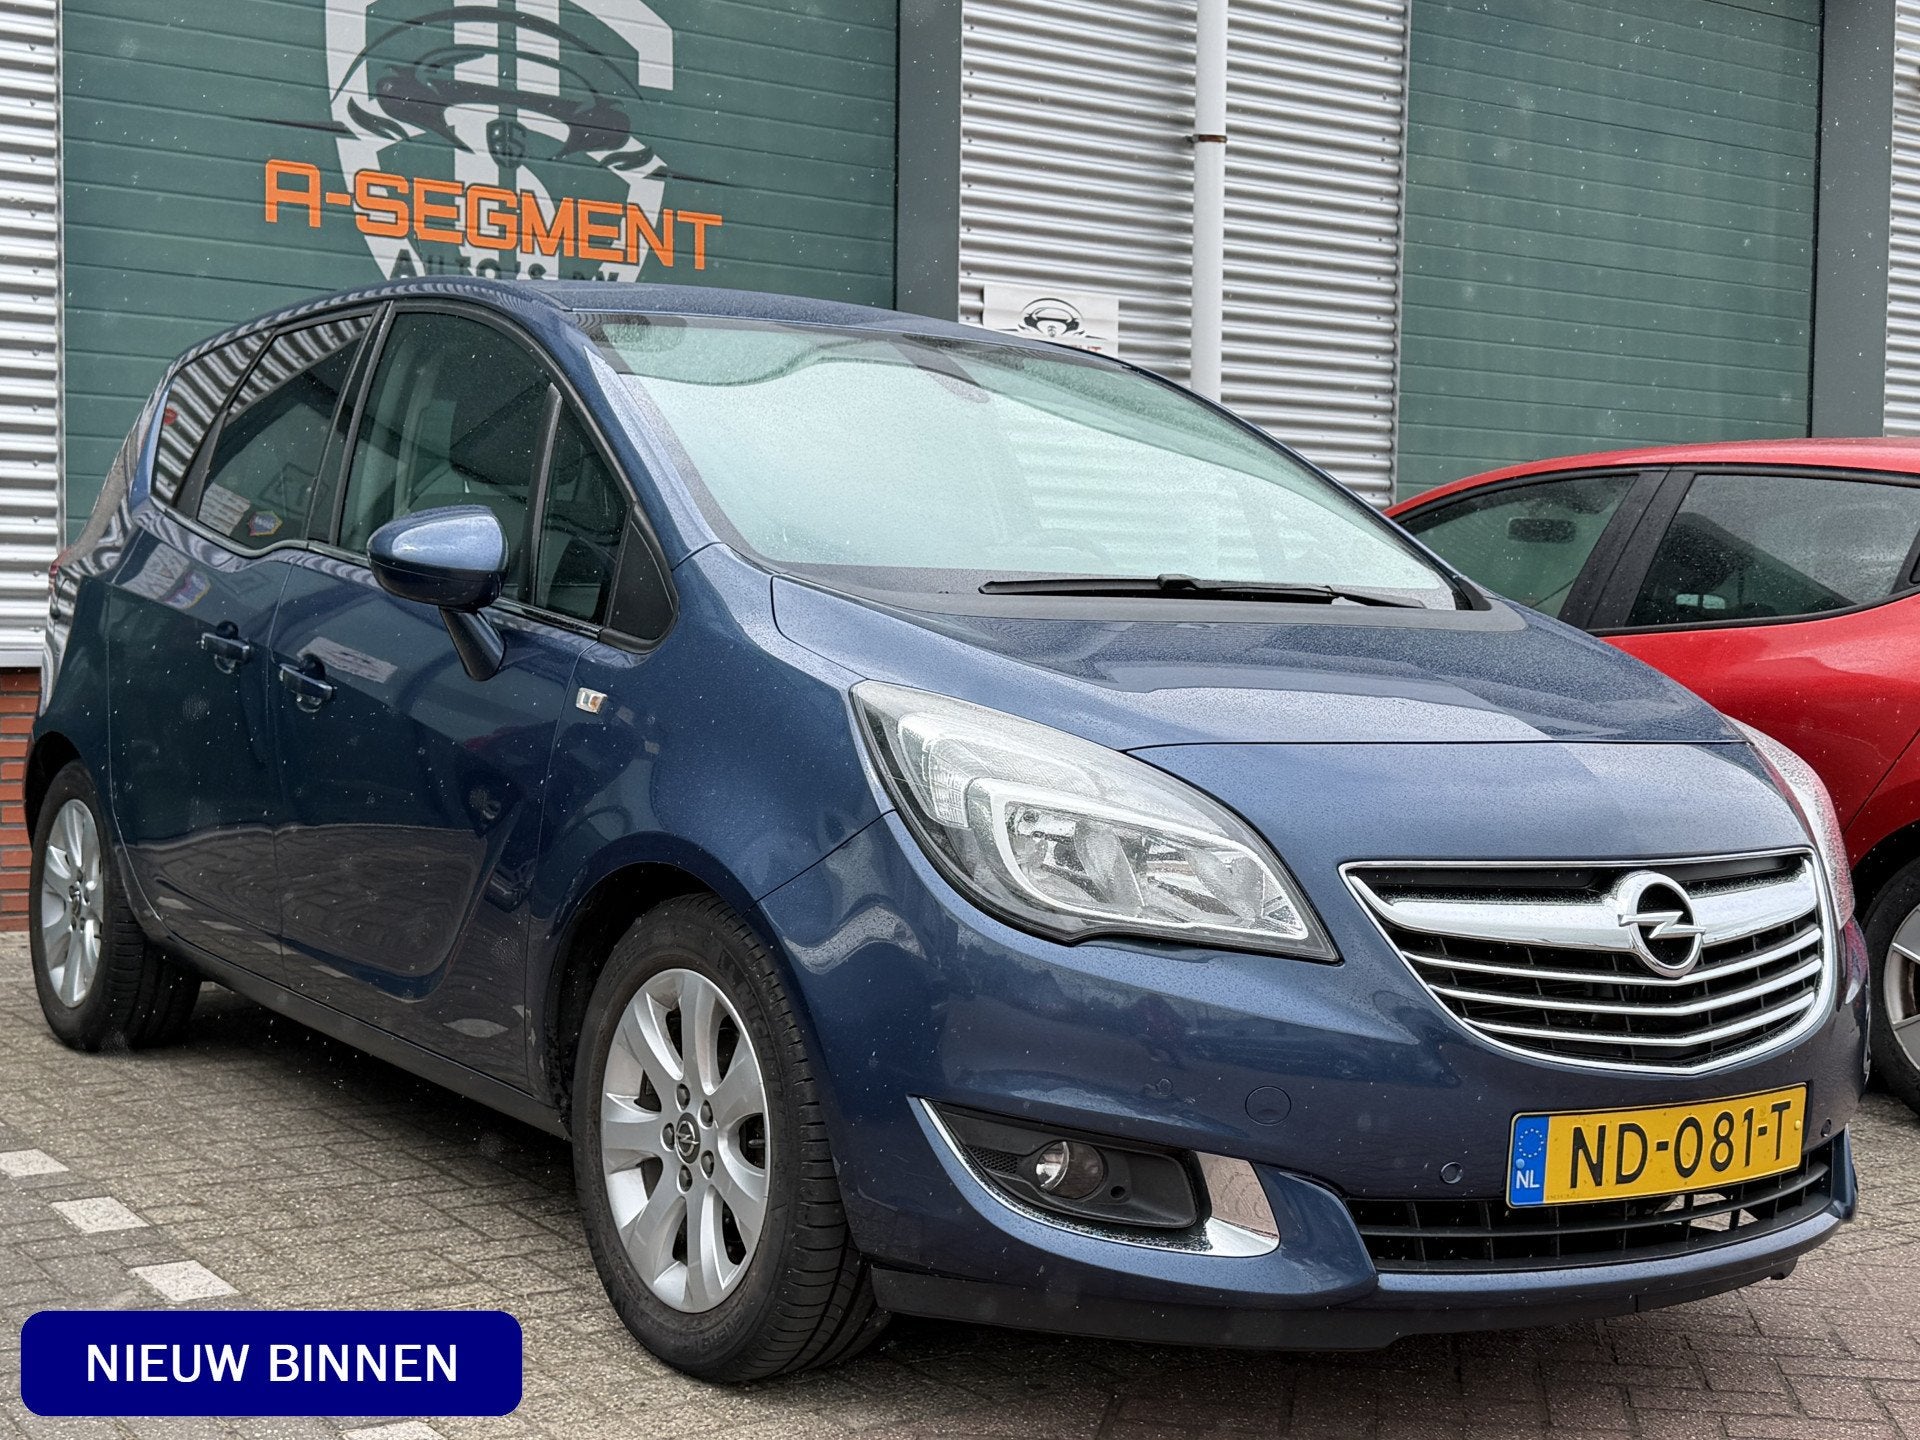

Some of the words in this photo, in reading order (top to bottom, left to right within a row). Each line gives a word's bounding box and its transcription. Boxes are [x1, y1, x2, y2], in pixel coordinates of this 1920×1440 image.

[265, 158, 723, 270] A-SEGMENT
[1515, 1169, 1540, 1189] NL
[1570, 1099, 1792, 1189] ND-081-T
